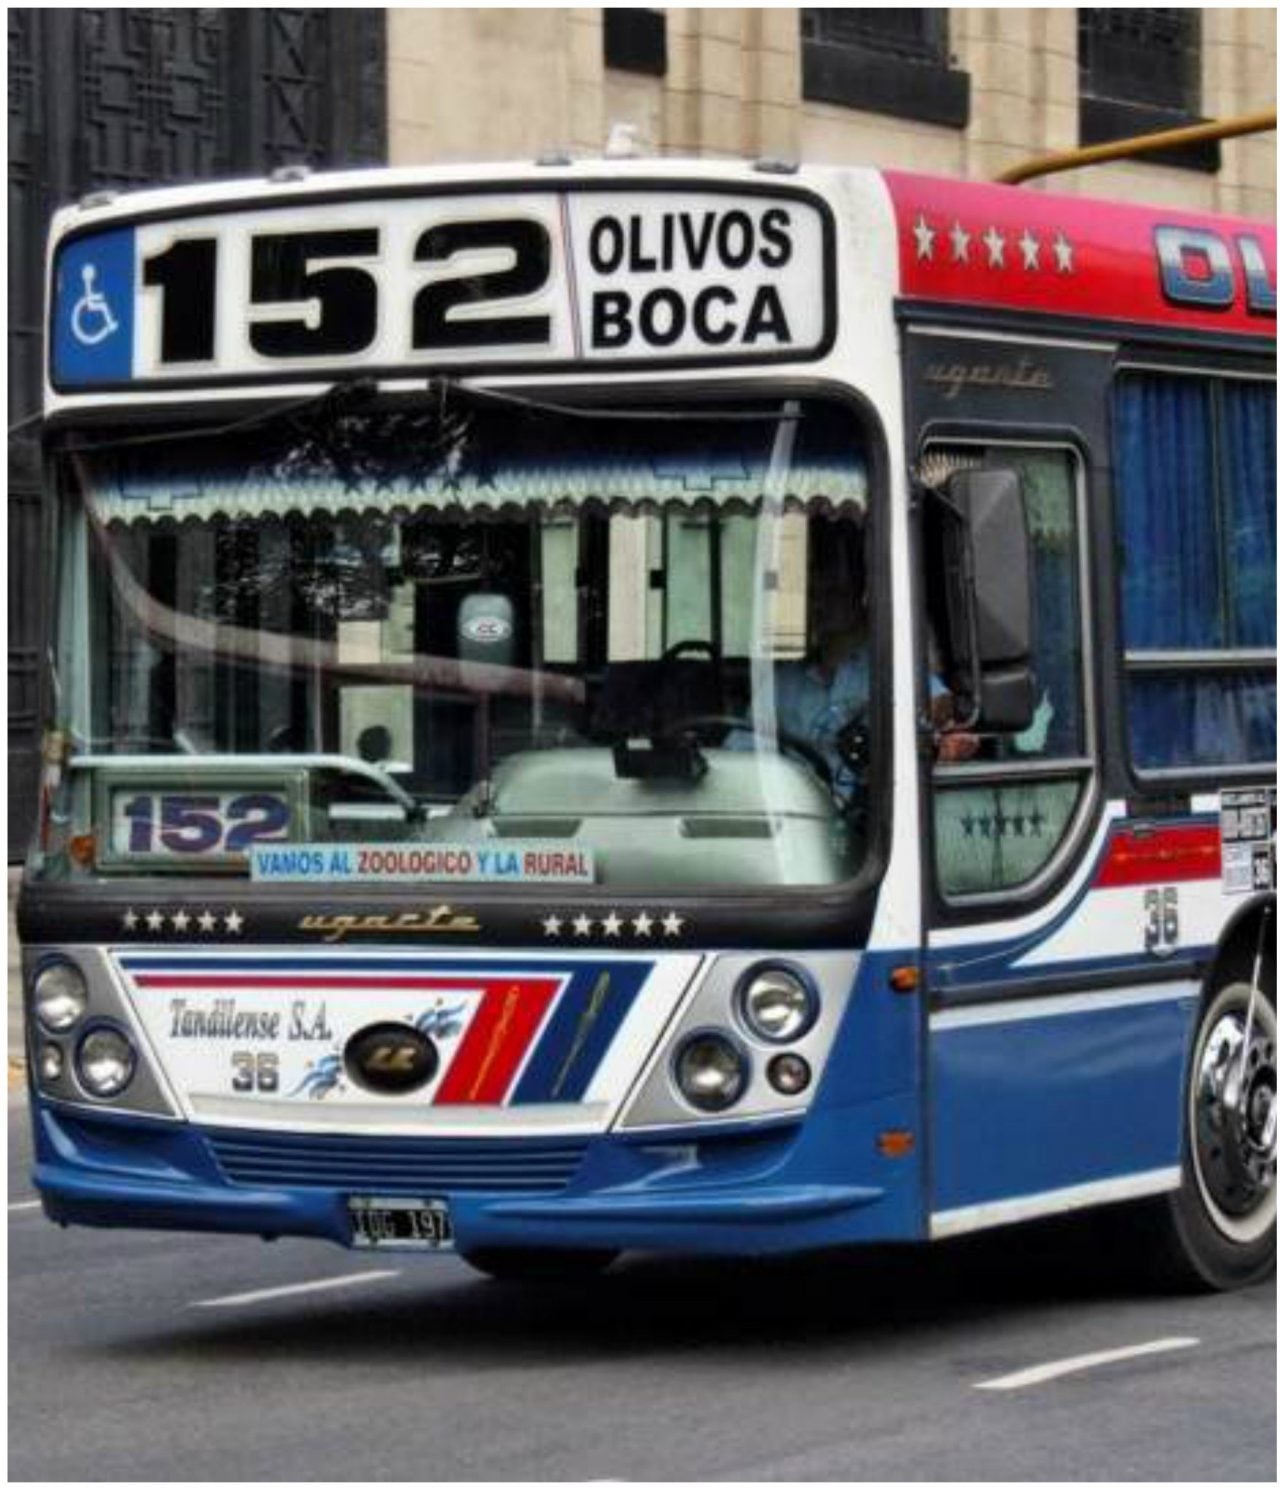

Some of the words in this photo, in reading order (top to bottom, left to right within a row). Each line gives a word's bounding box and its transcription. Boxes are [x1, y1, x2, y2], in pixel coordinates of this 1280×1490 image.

[588, 207, 793, 276] OLIVOS
[142, 217, 553, 364] 152
[590, 284, 793, 349] BOCA
[122, 793, 290, 854] 152
[257, 850, 324, 877] VAMOS
[328, 851, 352, 876] AL
[357, 851, 471, 876] ZOOLOGICO
[476, 853, 489, 876] Y
[494, 853, 519, 876] LA
[523, 852, 589, 877] RURAL
[1144, 886, 1178, 948] 36
[169, 998, 281, 1039] Tandilense
[287, 998, 334, 1040] S.A.
[231, 1051, 280, 1092] 36
